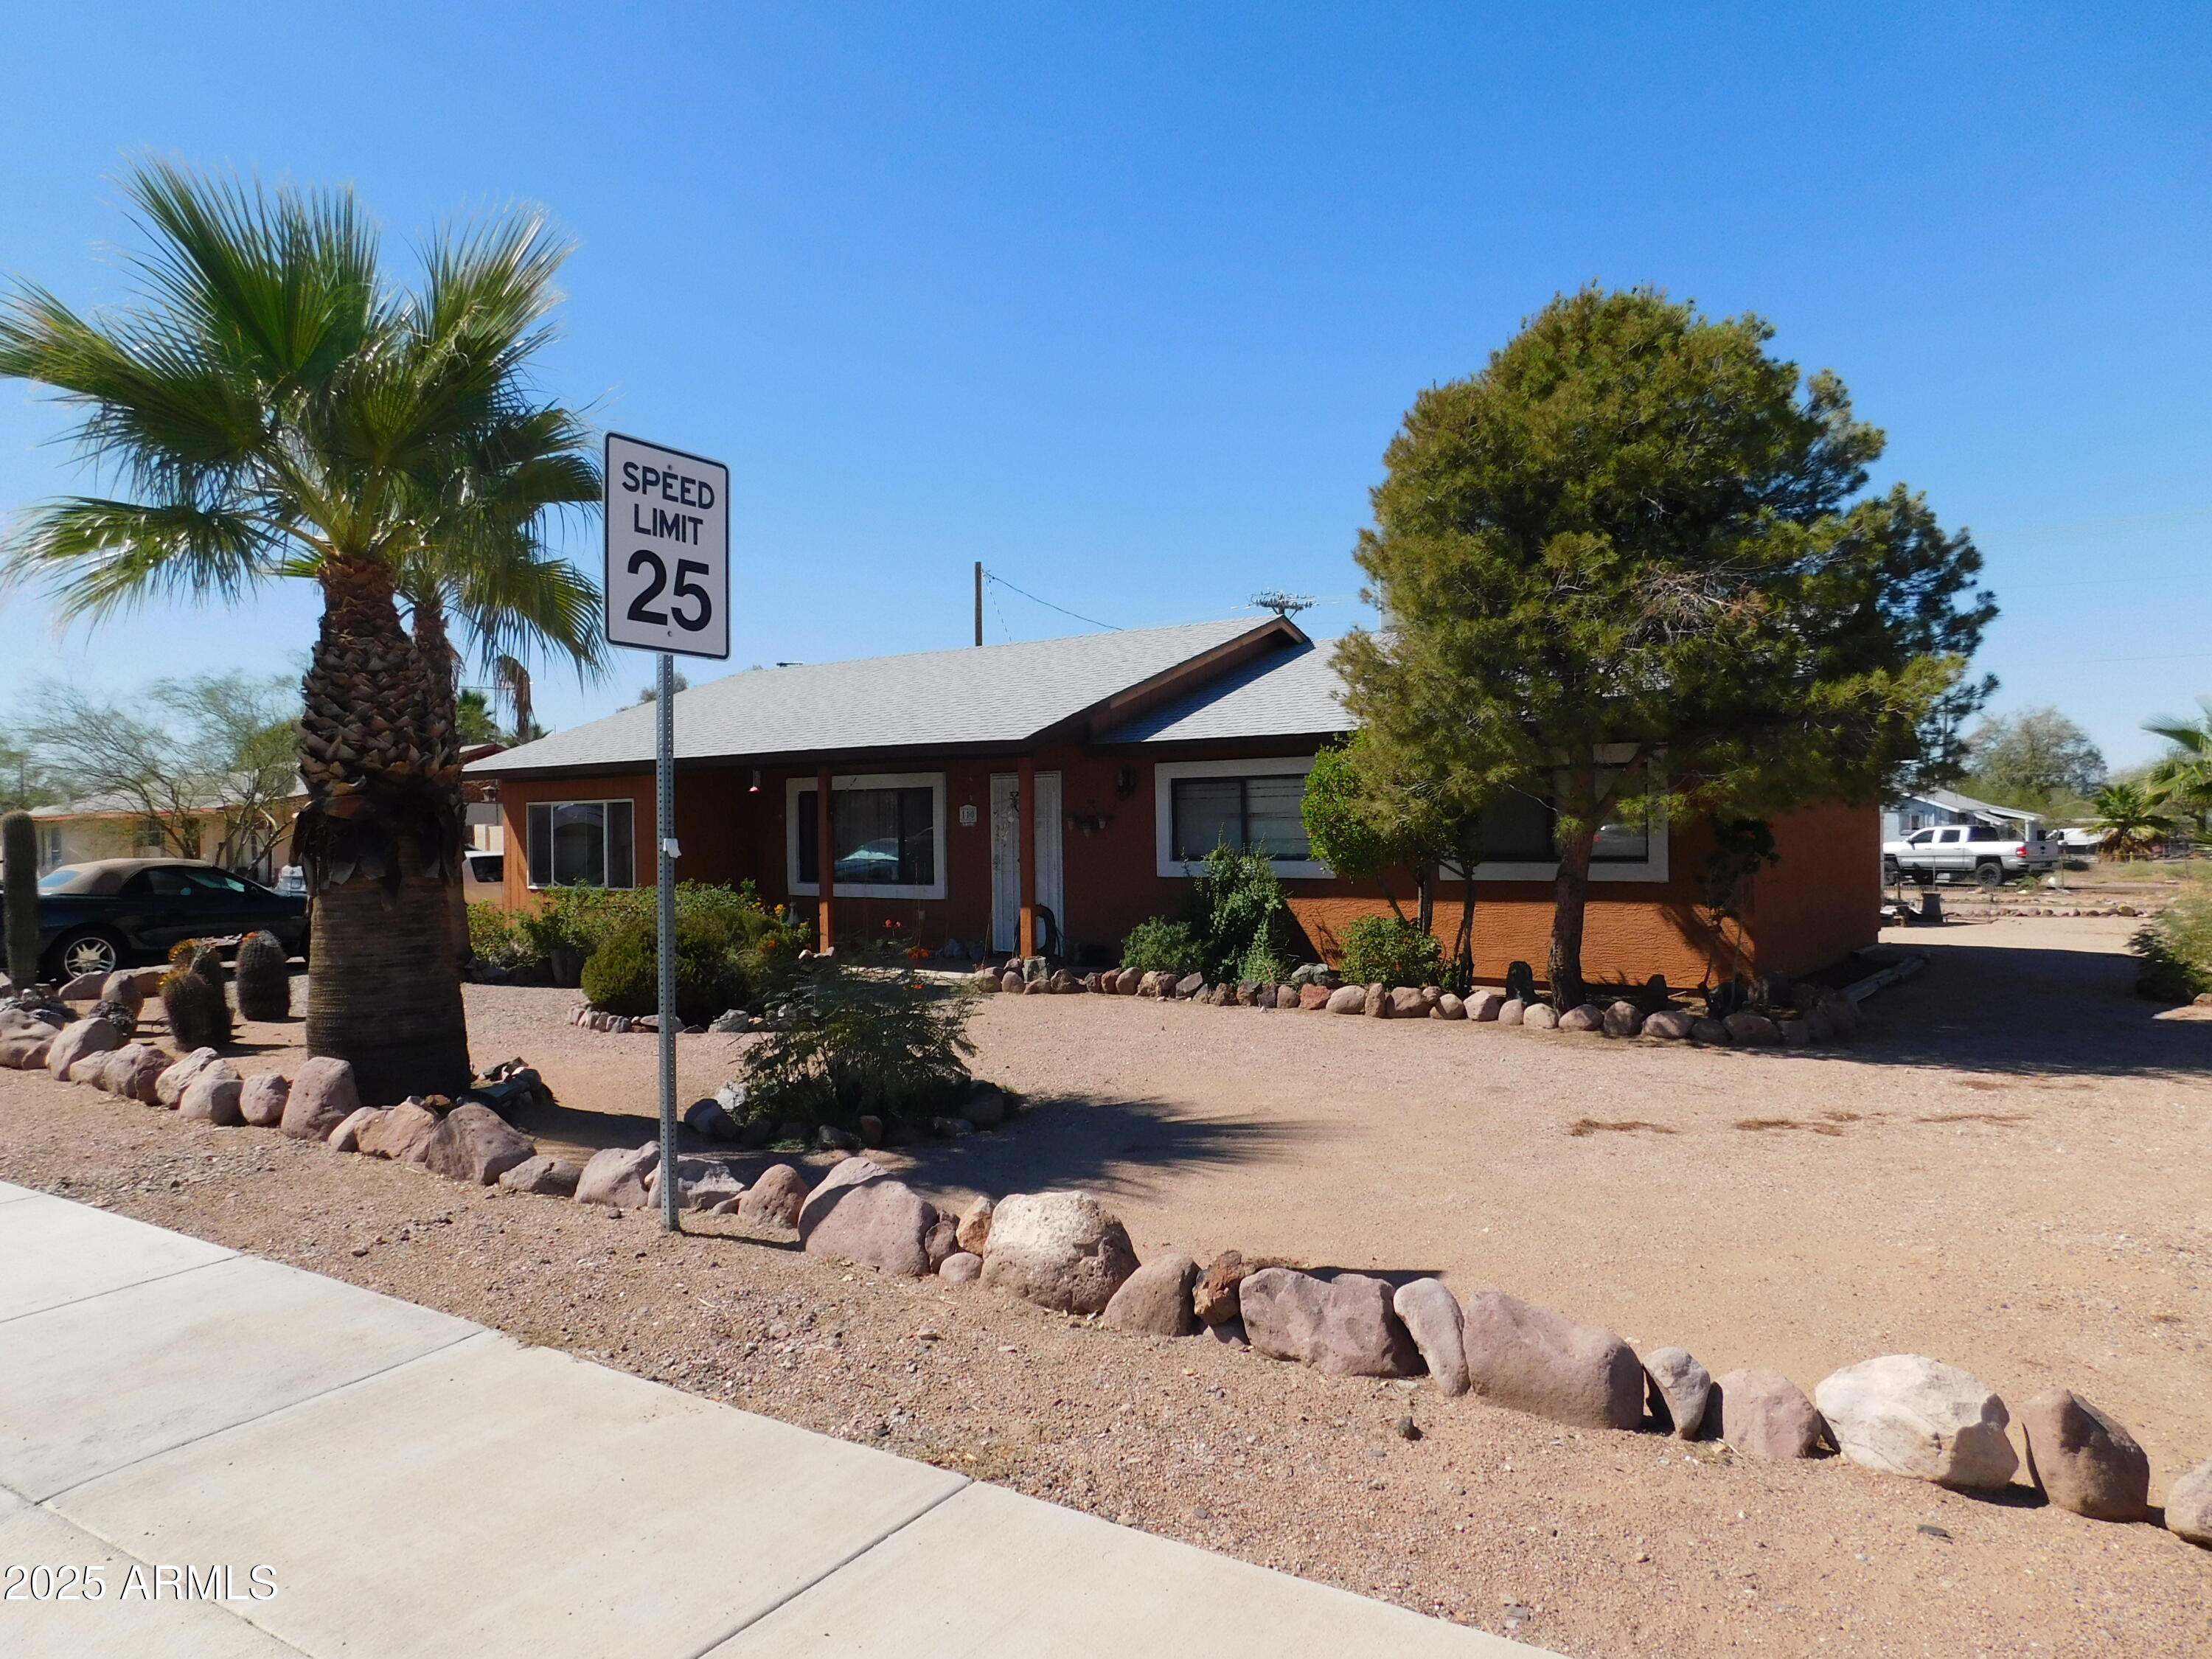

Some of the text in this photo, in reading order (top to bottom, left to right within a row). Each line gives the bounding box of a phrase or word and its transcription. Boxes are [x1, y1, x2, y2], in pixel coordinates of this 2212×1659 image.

[622, 462, 715, 509] SPEED
[634, 504, 703, 546] LIMIT
[627, 549, 712, 632] 25
